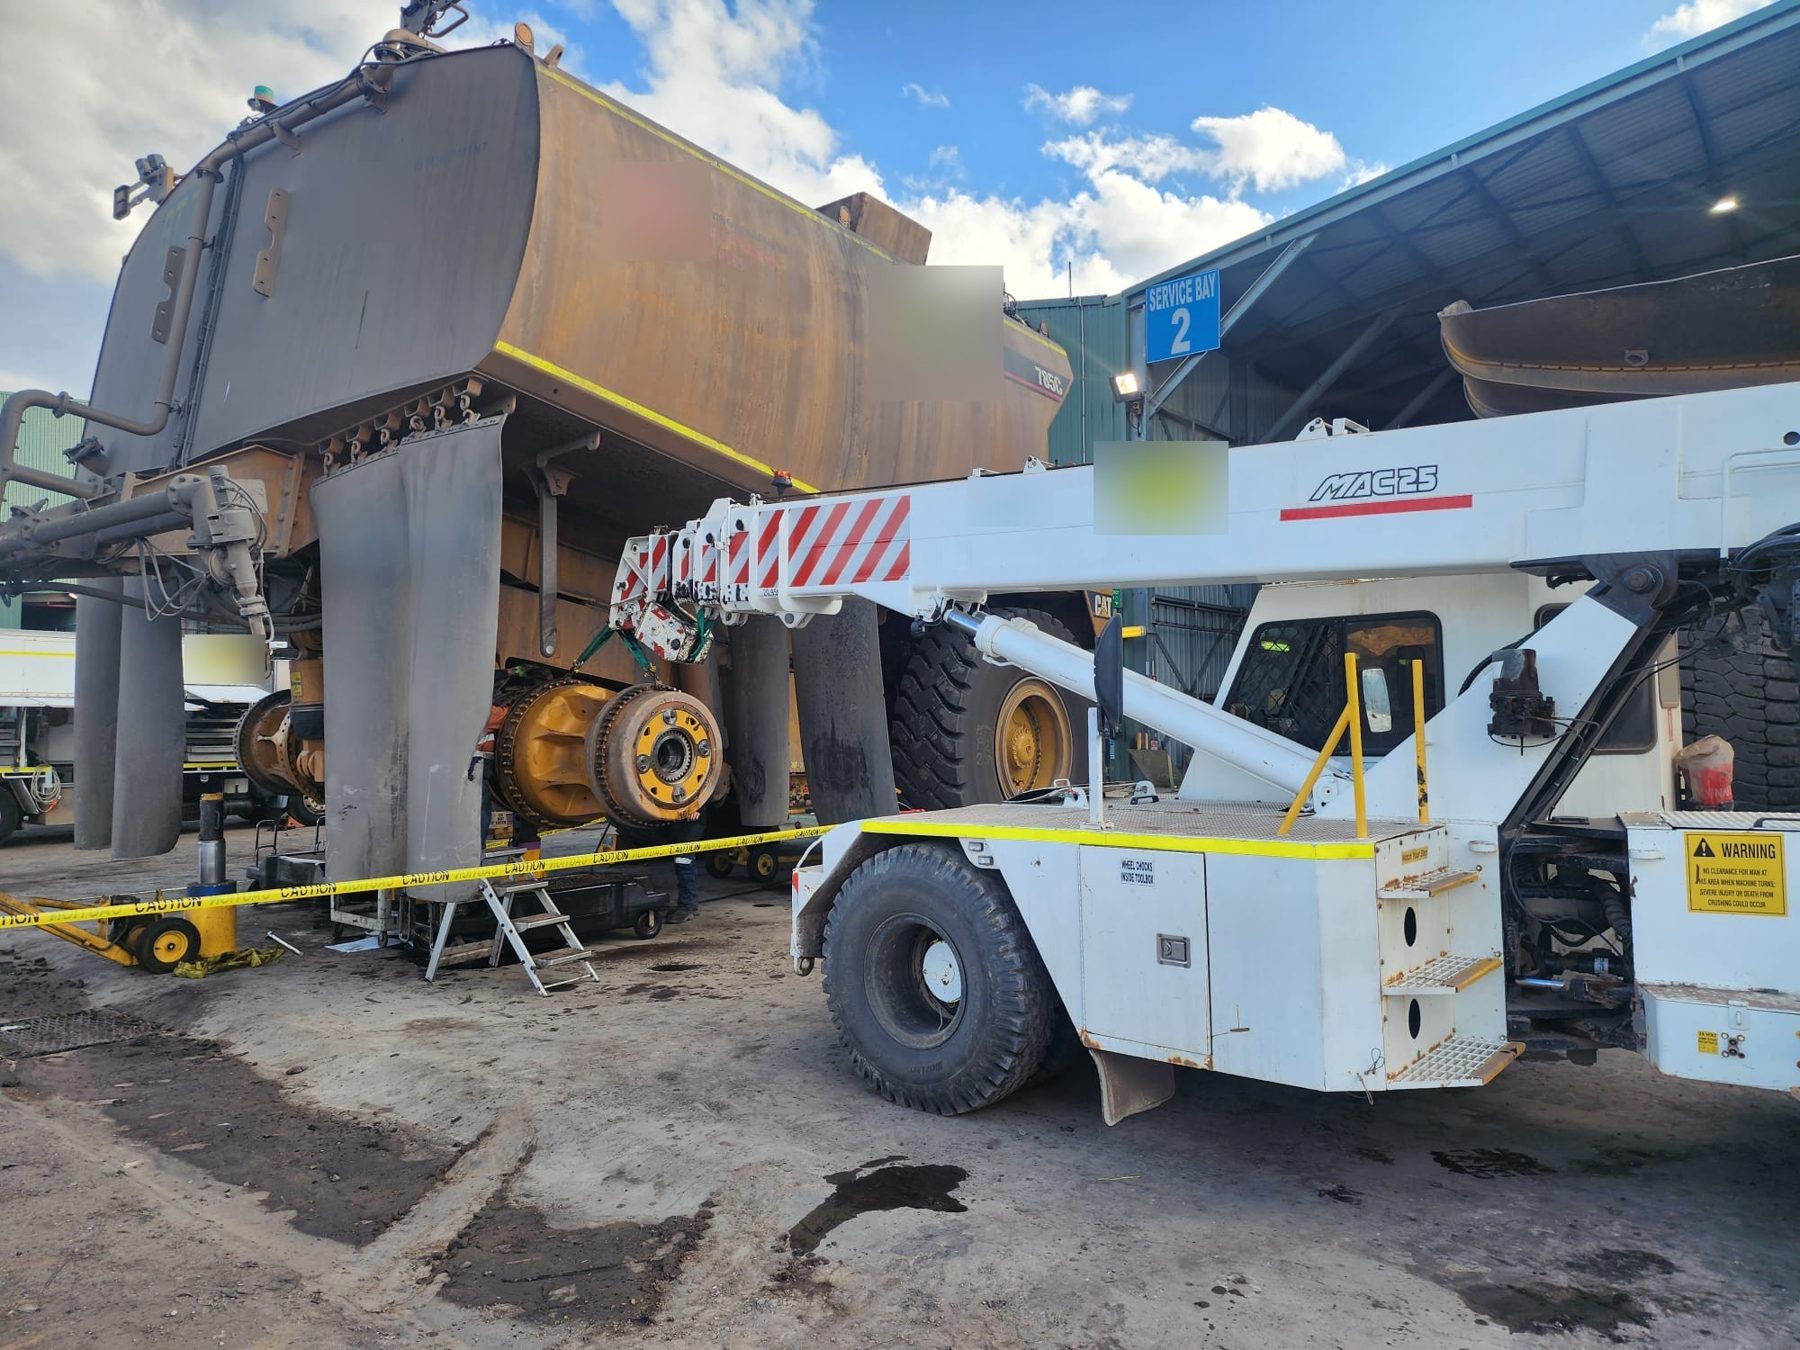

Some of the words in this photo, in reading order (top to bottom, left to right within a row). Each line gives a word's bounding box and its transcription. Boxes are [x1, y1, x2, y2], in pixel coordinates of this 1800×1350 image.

[1149, 279, 1193, 312] SERVICE
[1195, 272, 1216, 301] BAY
[1170, 307, 1191, 355] 2
[1034, 365, 1063, 395] 785C
[1094, 594, 1112, 617] CAT
[593, 850, 629, 863] CAUTION
[1721, 842, 1776, 859] WARNING
[504, 861, 546, 874] CAUTION
[1121, 860, 1135, 870] WHEEL
[1136, 861, 1153, 872] CHOCKS
[402, 870, 449, 885] CAUTION
[1121, 872, 1134, 882] INSIDE
[1135, 873, 1154, 884] TOOLBOX
[1735, 879, 1757, 887] MACHINE
[281, 882, 336, 898] CAUTION
[135, 897, 202, 913] CAUTION
